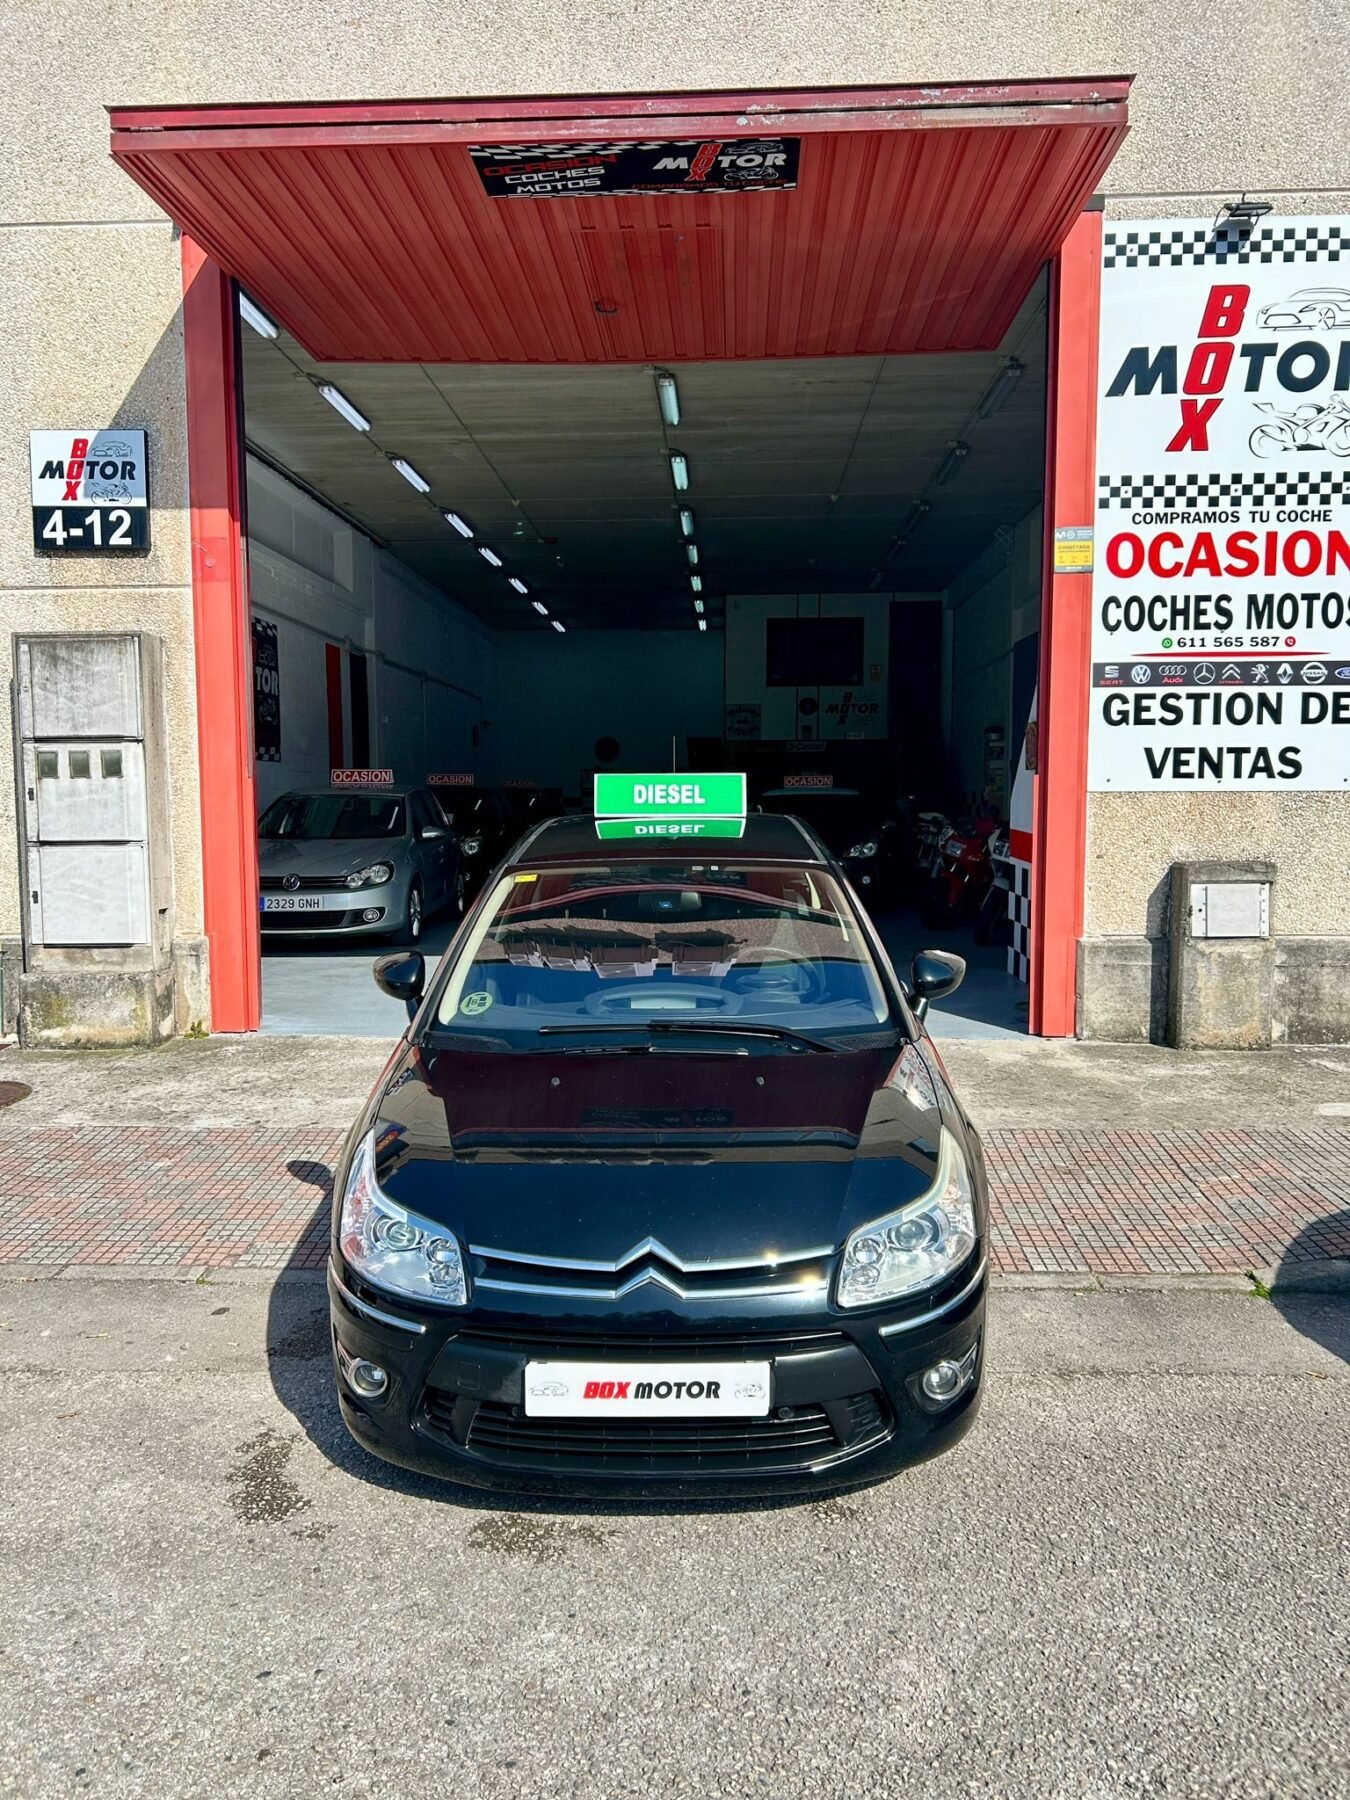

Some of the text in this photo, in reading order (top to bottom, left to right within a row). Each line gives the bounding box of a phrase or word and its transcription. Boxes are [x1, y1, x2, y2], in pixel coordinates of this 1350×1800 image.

[483, 154, 618, 176] OCASION
[652, 153, 788, 170] MOTOR
[684, 143, 723, 181] BOX
[504, 166, 605, 184] COCHES
[516, 178, 601, 193] MOTOS
[1164, 284, 1251, 452] BOX
[38, 460, 136, 480] MOTOR
[61, 438, 89, 501] BOX
[1132, 509, 1333, 525] COMPRAMOS TU COCHE
[42, 509, 133, 546] 4-12
[1105, 530, 1350, 579] OCASION
[1101, 591, 1350, 632] COCHES MOTO
[1177, 636, 1280, 648] 611 565 587
[1162, 676, 1183, 684] Audi
[1102, 691, 1350, 727] GESTION DE
[1143, 745, 1303, 780] VENTAS
[333, 771, 390, 782] OCASION
[428, 775, 472, 784] OCASION
[785, 777, 831, 786] OCASION
[633, 784, 705, 804] DIESEL
[266, 898, 320, 909] 2329 GNH
[583, 1381, 722, 1399] BOX MOTOR
